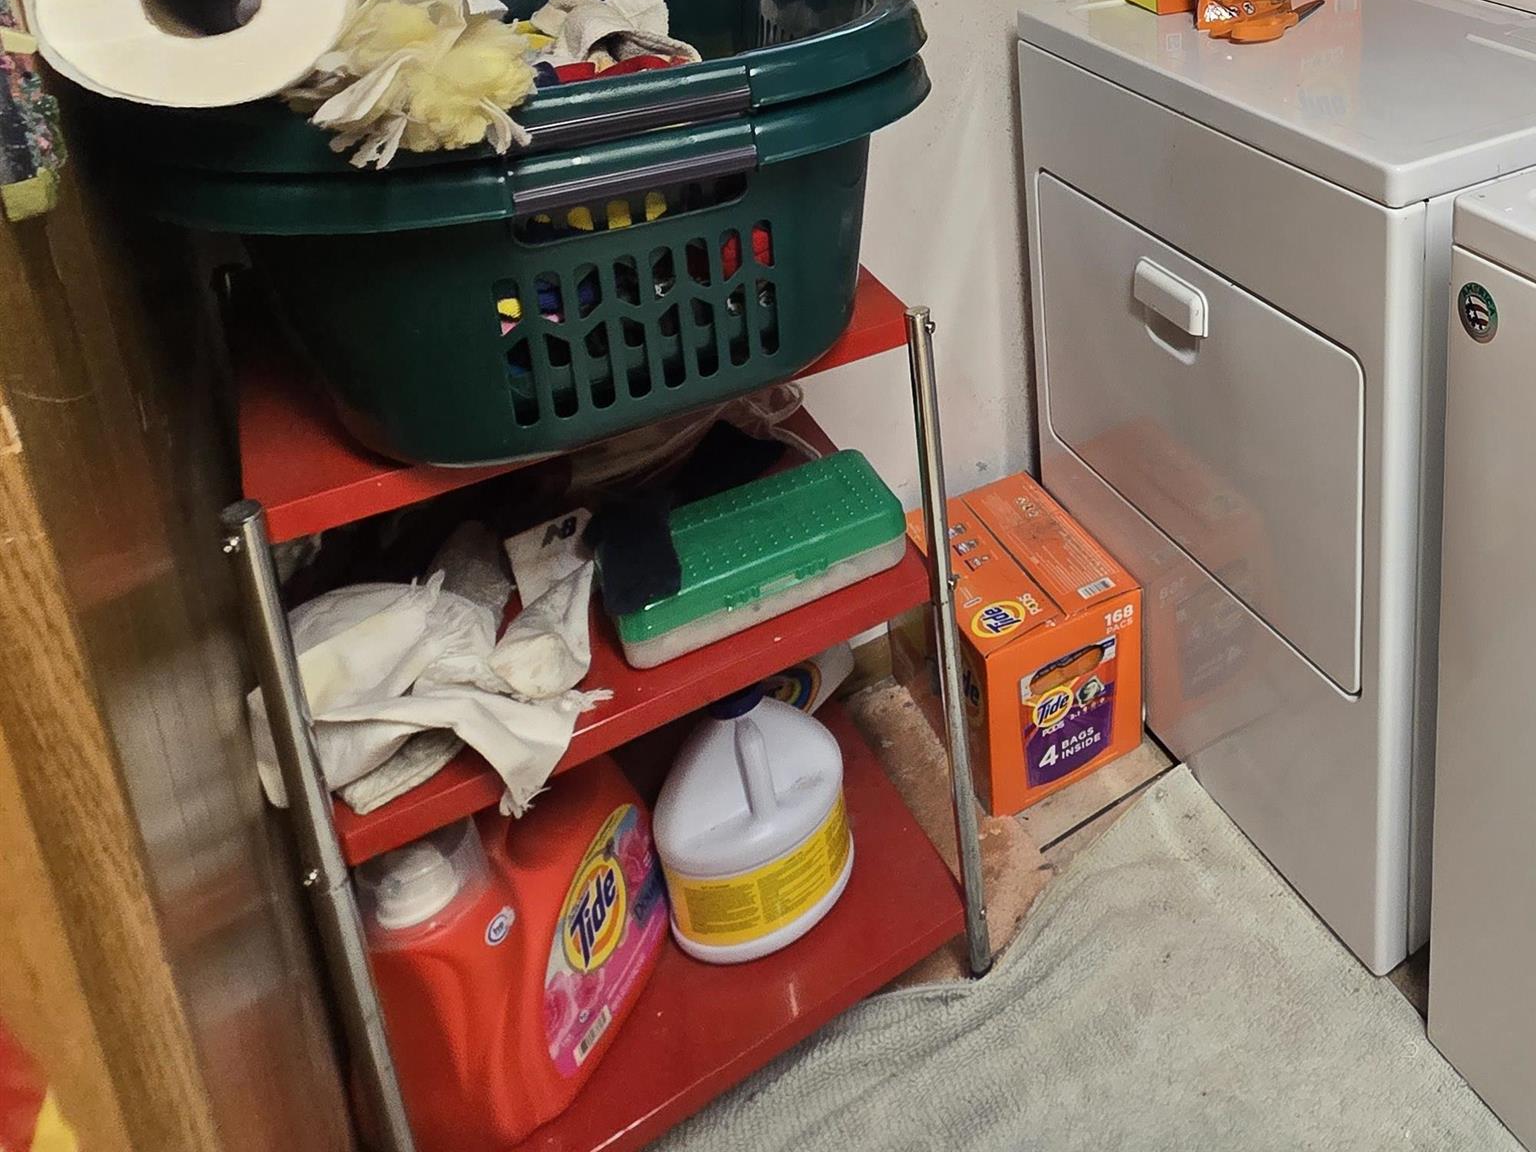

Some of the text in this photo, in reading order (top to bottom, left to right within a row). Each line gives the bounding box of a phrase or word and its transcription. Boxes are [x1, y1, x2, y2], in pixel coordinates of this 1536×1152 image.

[984, 607, 1022, 633] Tide
[1104, 604, 1134, 626] 168
[1106, 618, 1134, 634] PACS
[1038, 695, 1070, 725] Tide
[1039, 726, 1095, 768] 4 BAGS
[1061, 732, 1102, 759] INSIDE
[569, 867, 618, 970] Tide
